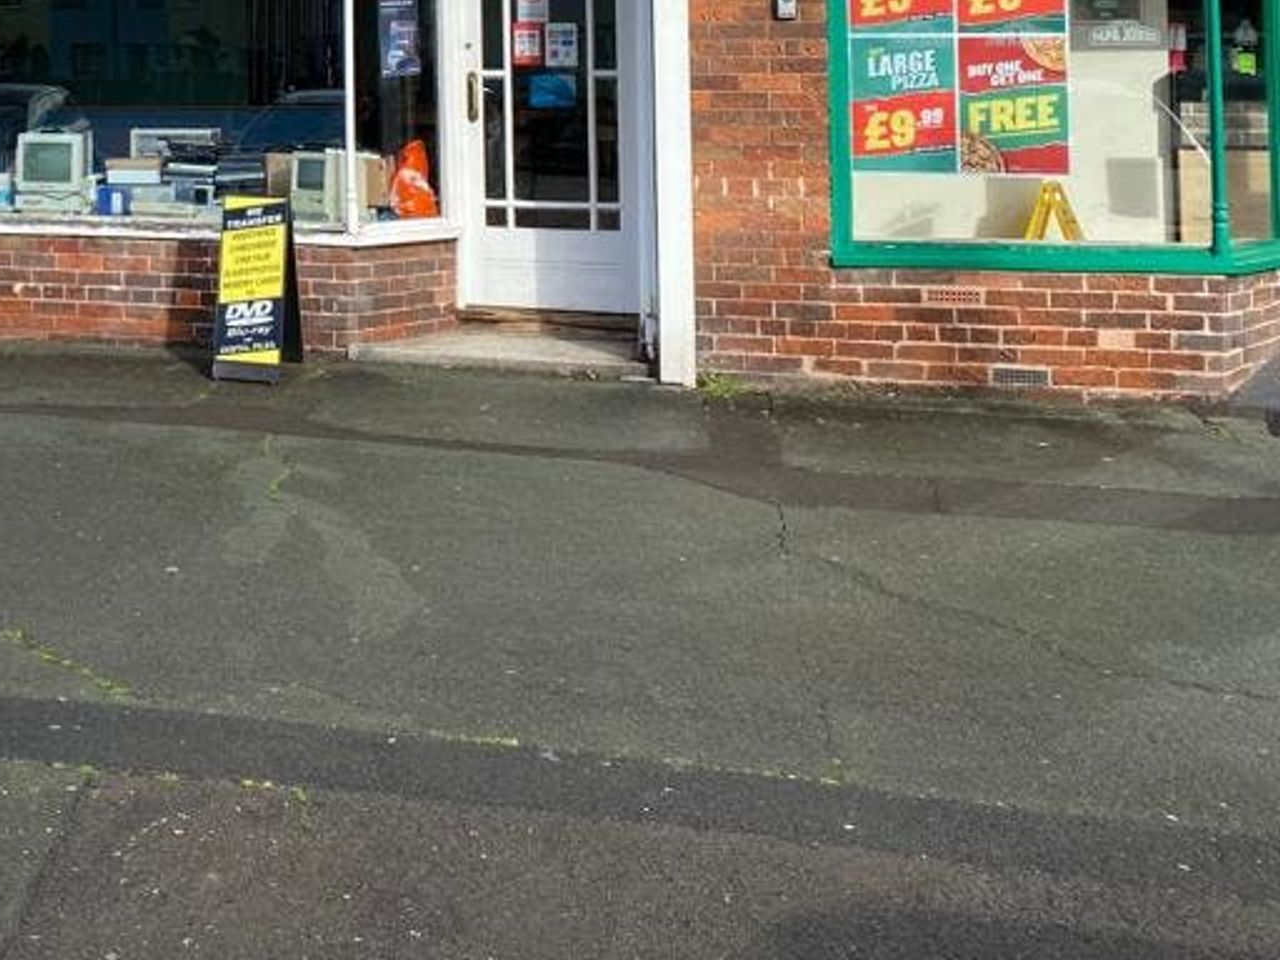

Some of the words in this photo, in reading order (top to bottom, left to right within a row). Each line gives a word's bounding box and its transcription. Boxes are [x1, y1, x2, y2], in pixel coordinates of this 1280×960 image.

[868, 49, 937, 77] LARGE
[967, 64, 994, 78] BUY
[994, 60, 1022, 76] ONE
[892, 72, 939, 90] PIZZA
[967, 93, 1060, 135] FREE
[226, 300, 274, 319] DVD
